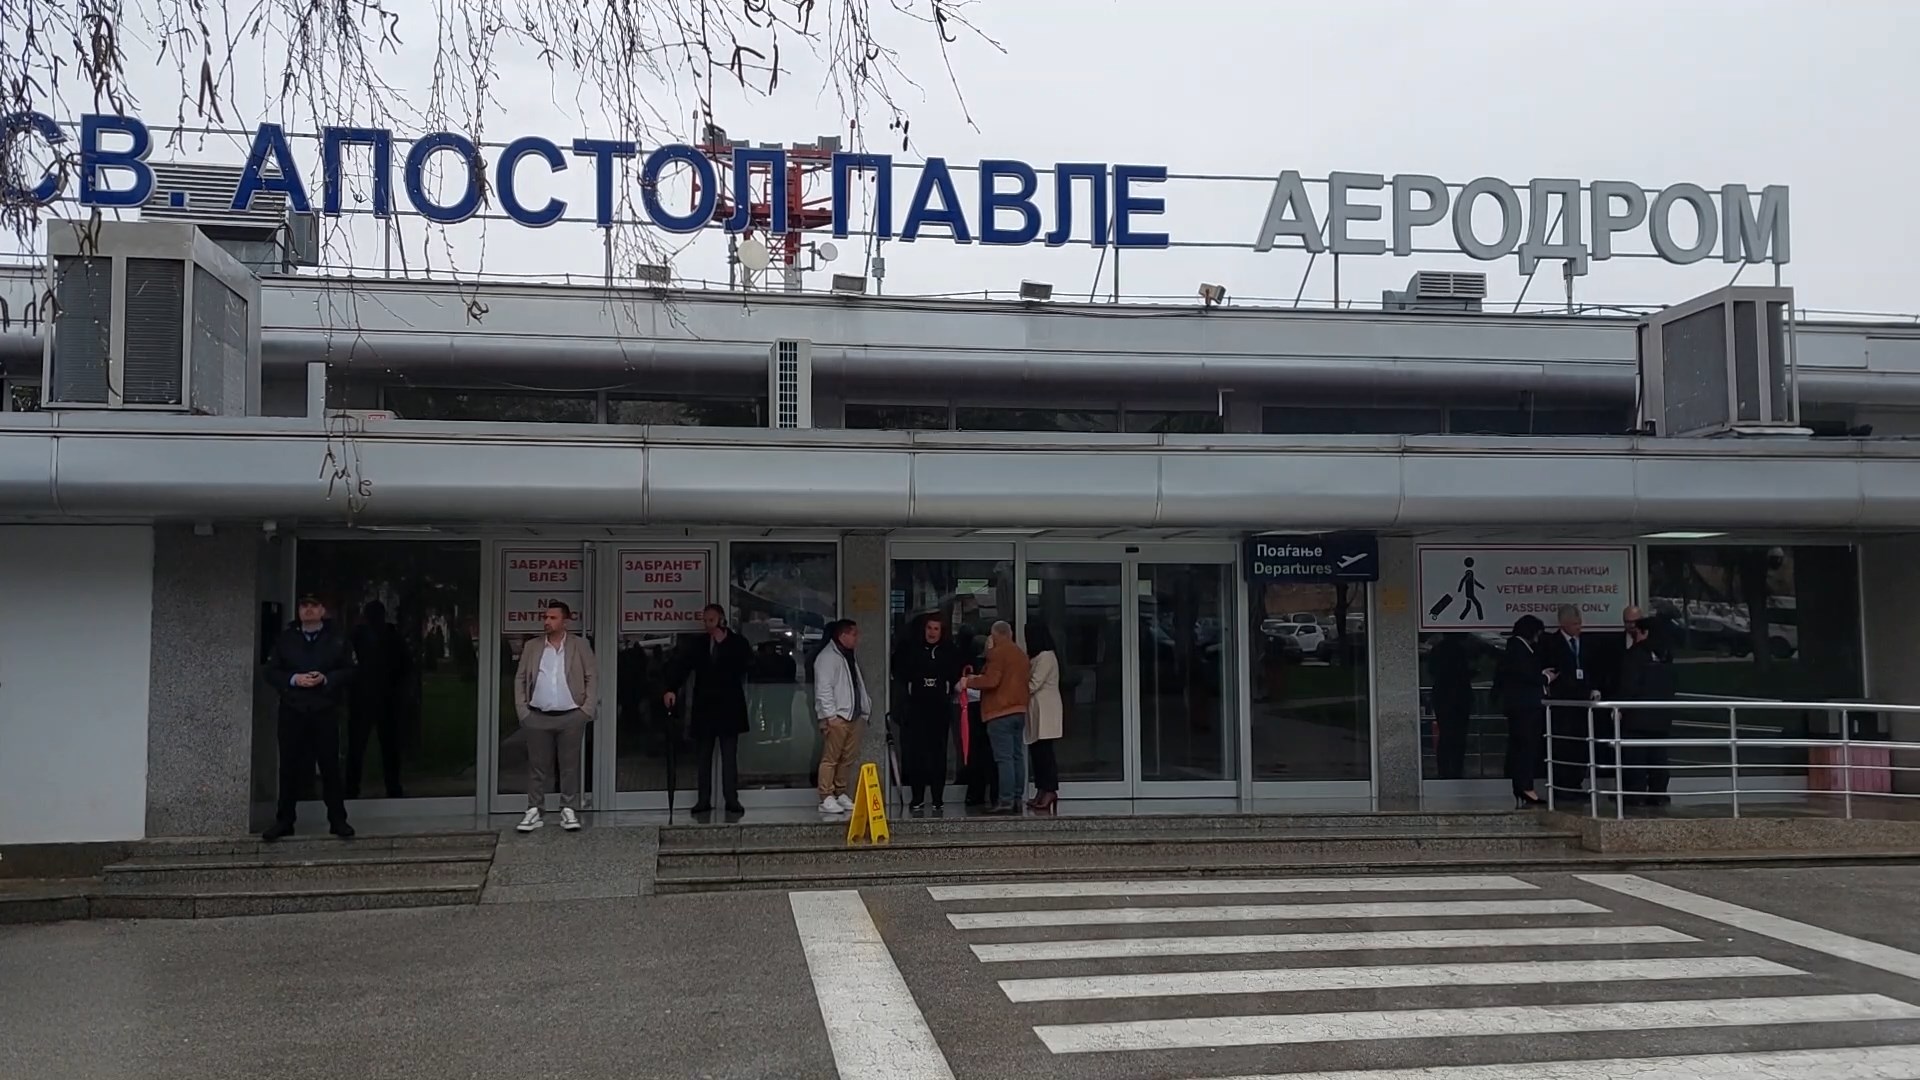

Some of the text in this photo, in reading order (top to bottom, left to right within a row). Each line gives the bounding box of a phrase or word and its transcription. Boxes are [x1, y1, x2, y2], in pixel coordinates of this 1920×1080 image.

[229, 122, 788, 235] АПОСТОЛ
[830, 151, 1170, 249] ПАВЛЕ
[1254, 169, 1791, 276] АЕРОДРОМ
[1257, 544, 1322, 557] Поаѓање
[625, 560, 702, 571] ЗАБРАНЕТ
[1254, 561, 1332, 577] Departures
[529, 572, 568, 582] ВЛЕЗ
[1505, 566, 1610, 577] САМО ЗА ПАТНИЦИ
[644, 572, 682, 583] ВЛЕЗ
[653, 598, 674, 609] NO
[1505, 603, 1610, 613] PASSENG ONLY
[508, 611, 583, 621] ENTRC
[624, 611, 705, 622] ENTRANCE
